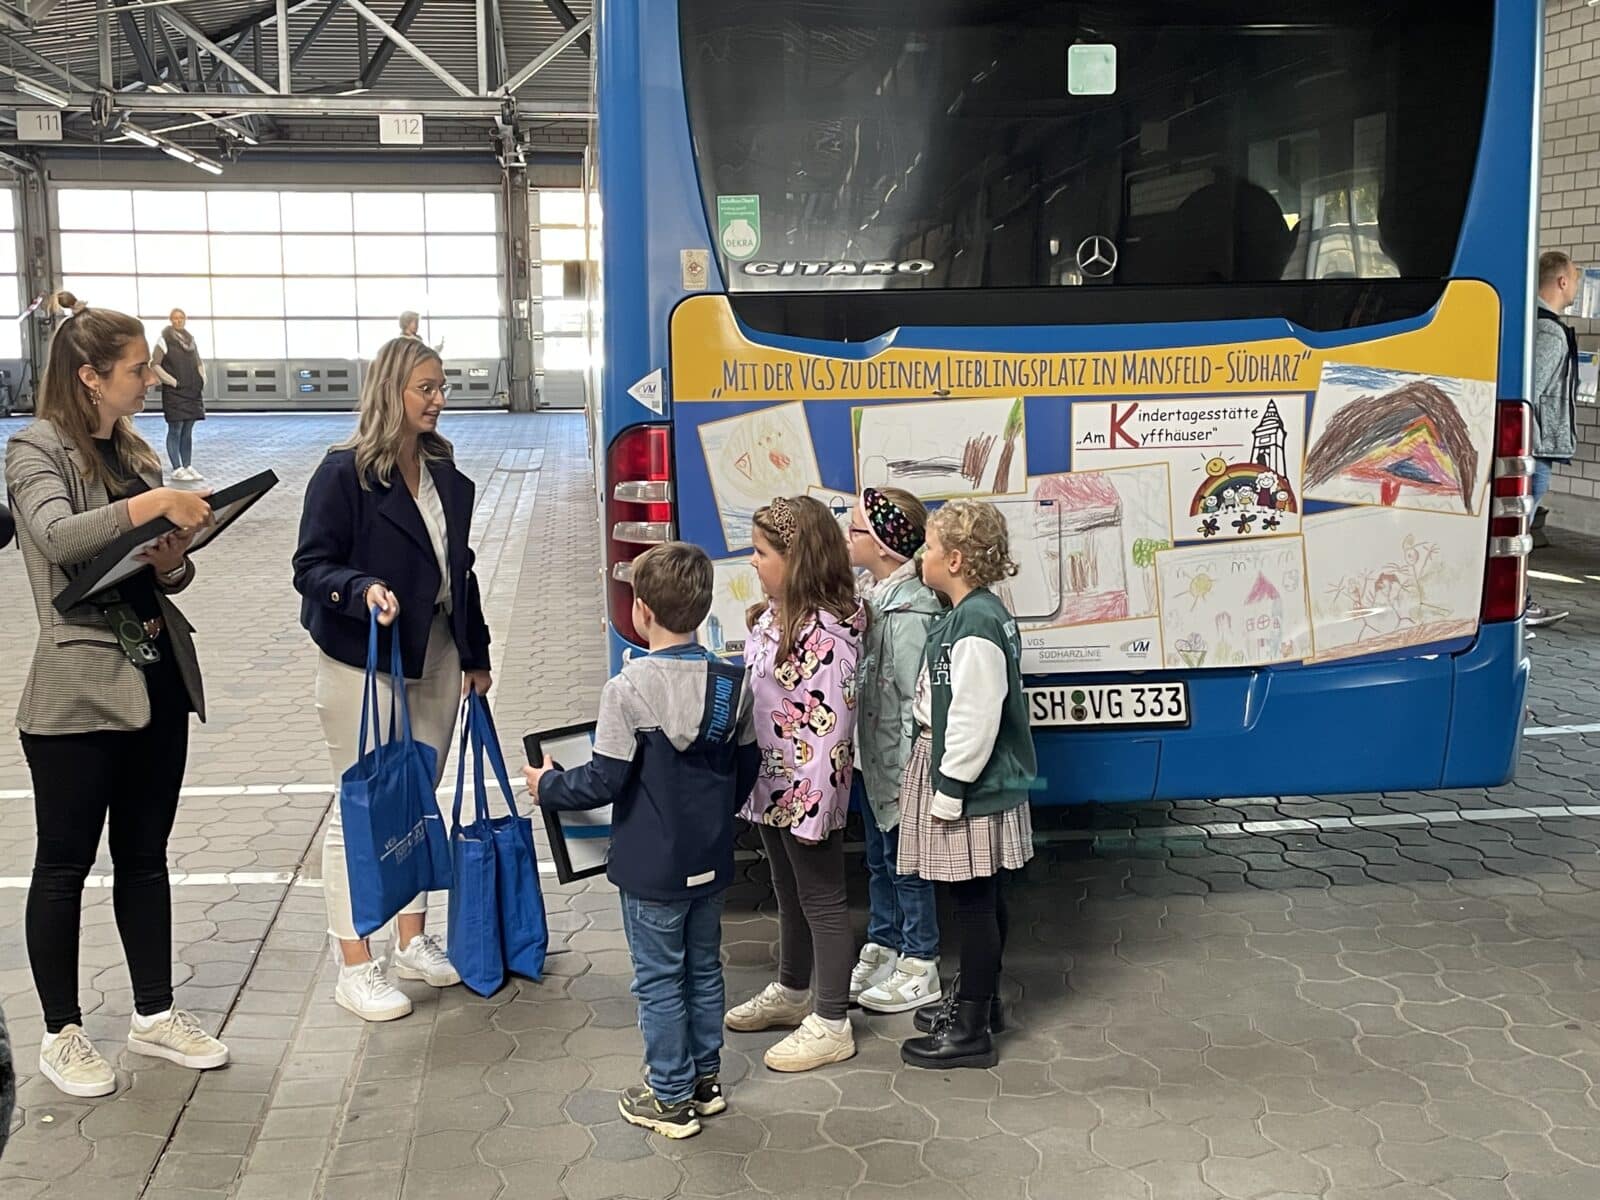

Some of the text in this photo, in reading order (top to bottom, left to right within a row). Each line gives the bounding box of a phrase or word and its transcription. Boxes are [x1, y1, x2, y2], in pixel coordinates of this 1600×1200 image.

[36, 114, 58, 131] 111
[393, 118, 419, 135] 112
[726, 239, 754, 248] DEKRA
[743, 259, 935, 276] CITARO
[764, 362, 794, 391] DER
[799, 358, 835, 391] VGS
[841, 361, 862, 390] ZU
[868, 360, 942, 390] DEINEM
[947, 356, 1087, 388] LIEBLINGSPLATZ
[1092, 358, 1117, 386] IN
[1132, 641, 1150, 652] VM
[1089, 689, 1123, 719] VG
[1130, 687, 1182, 717] 333
